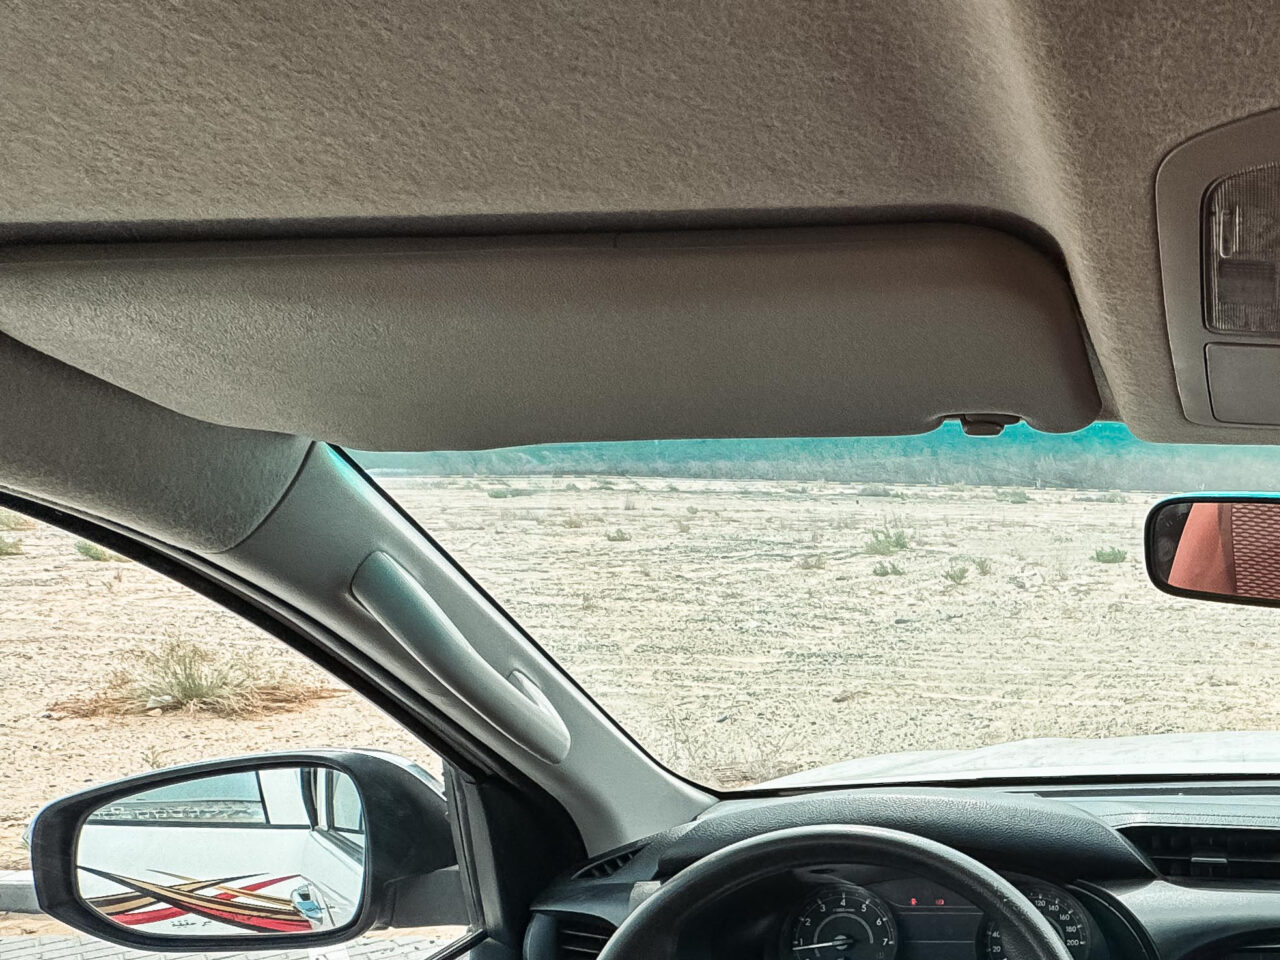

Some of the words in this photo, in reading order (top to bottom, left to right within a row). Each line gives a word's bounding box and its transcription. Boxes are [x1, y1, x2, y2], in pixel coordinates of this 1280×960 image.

[819, 904, 826, 912] 3
[861, 904, 867, 912] 5
[1048, 904, 1060, 912] 140
[1059, 913, 1070, 921] 160
[805, 918, 811, 926] 2
[876, 917, 882, 926] 6
[1065, 925, 1077, 933] 180
[882, 938, 888, 946] 7
[992, 945, 1001, 953] 20
